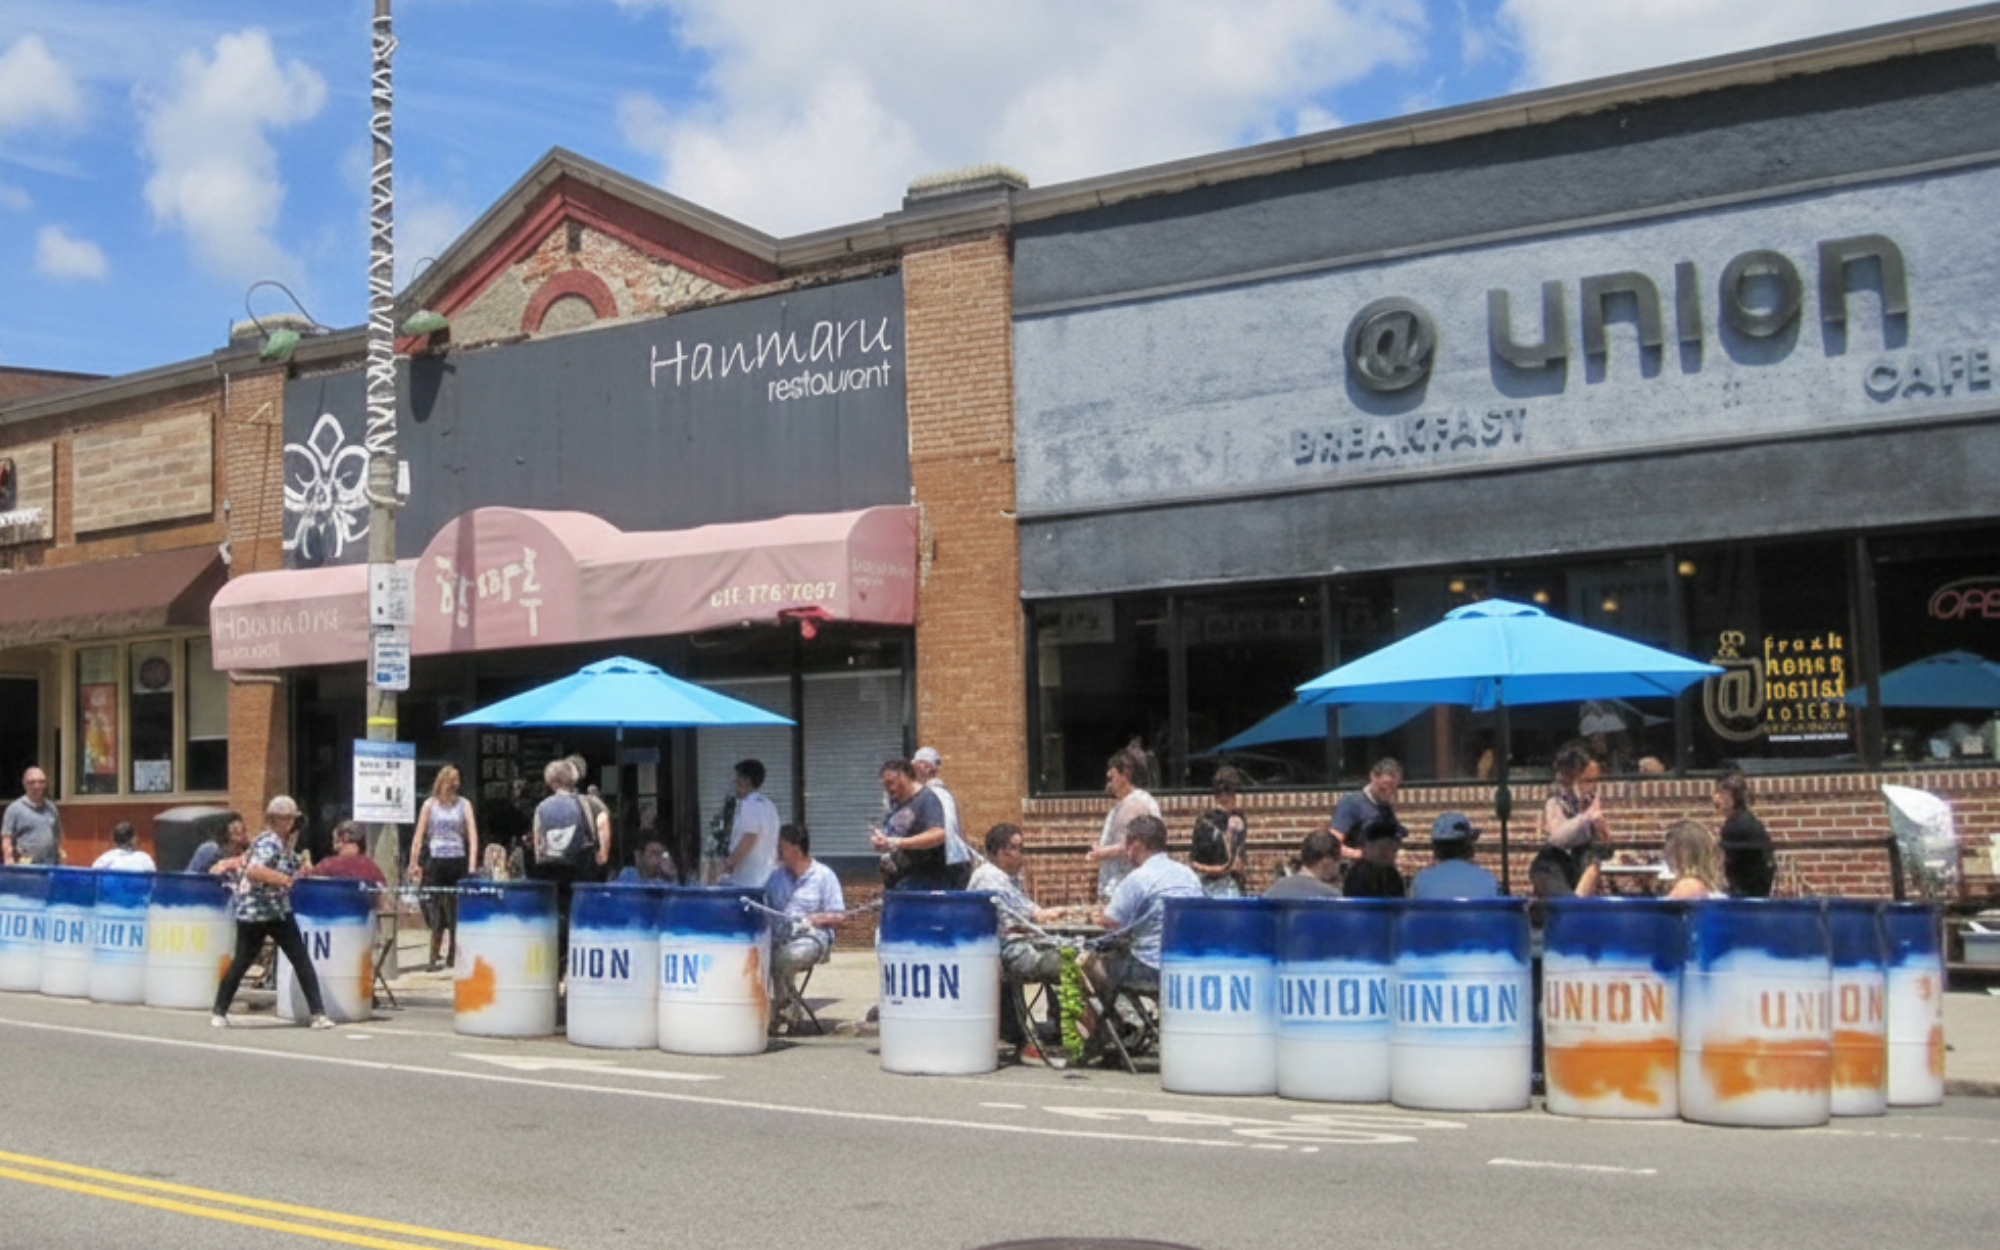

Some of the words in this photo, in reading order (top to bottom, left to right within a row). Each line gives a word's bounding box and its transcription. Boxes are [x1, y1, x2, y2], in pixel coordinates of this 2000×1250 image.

[650, 315, 892, 389] Hanmaru
[768, 358, 891, 402] restaurant
[1292, 406, 1527, 467] BREAKFAST
[1863, 349, 1991, 403] CAFE
[1280, 977, 1387, 1016] UNION
[1546, 980, 1664, 1022] UNION
